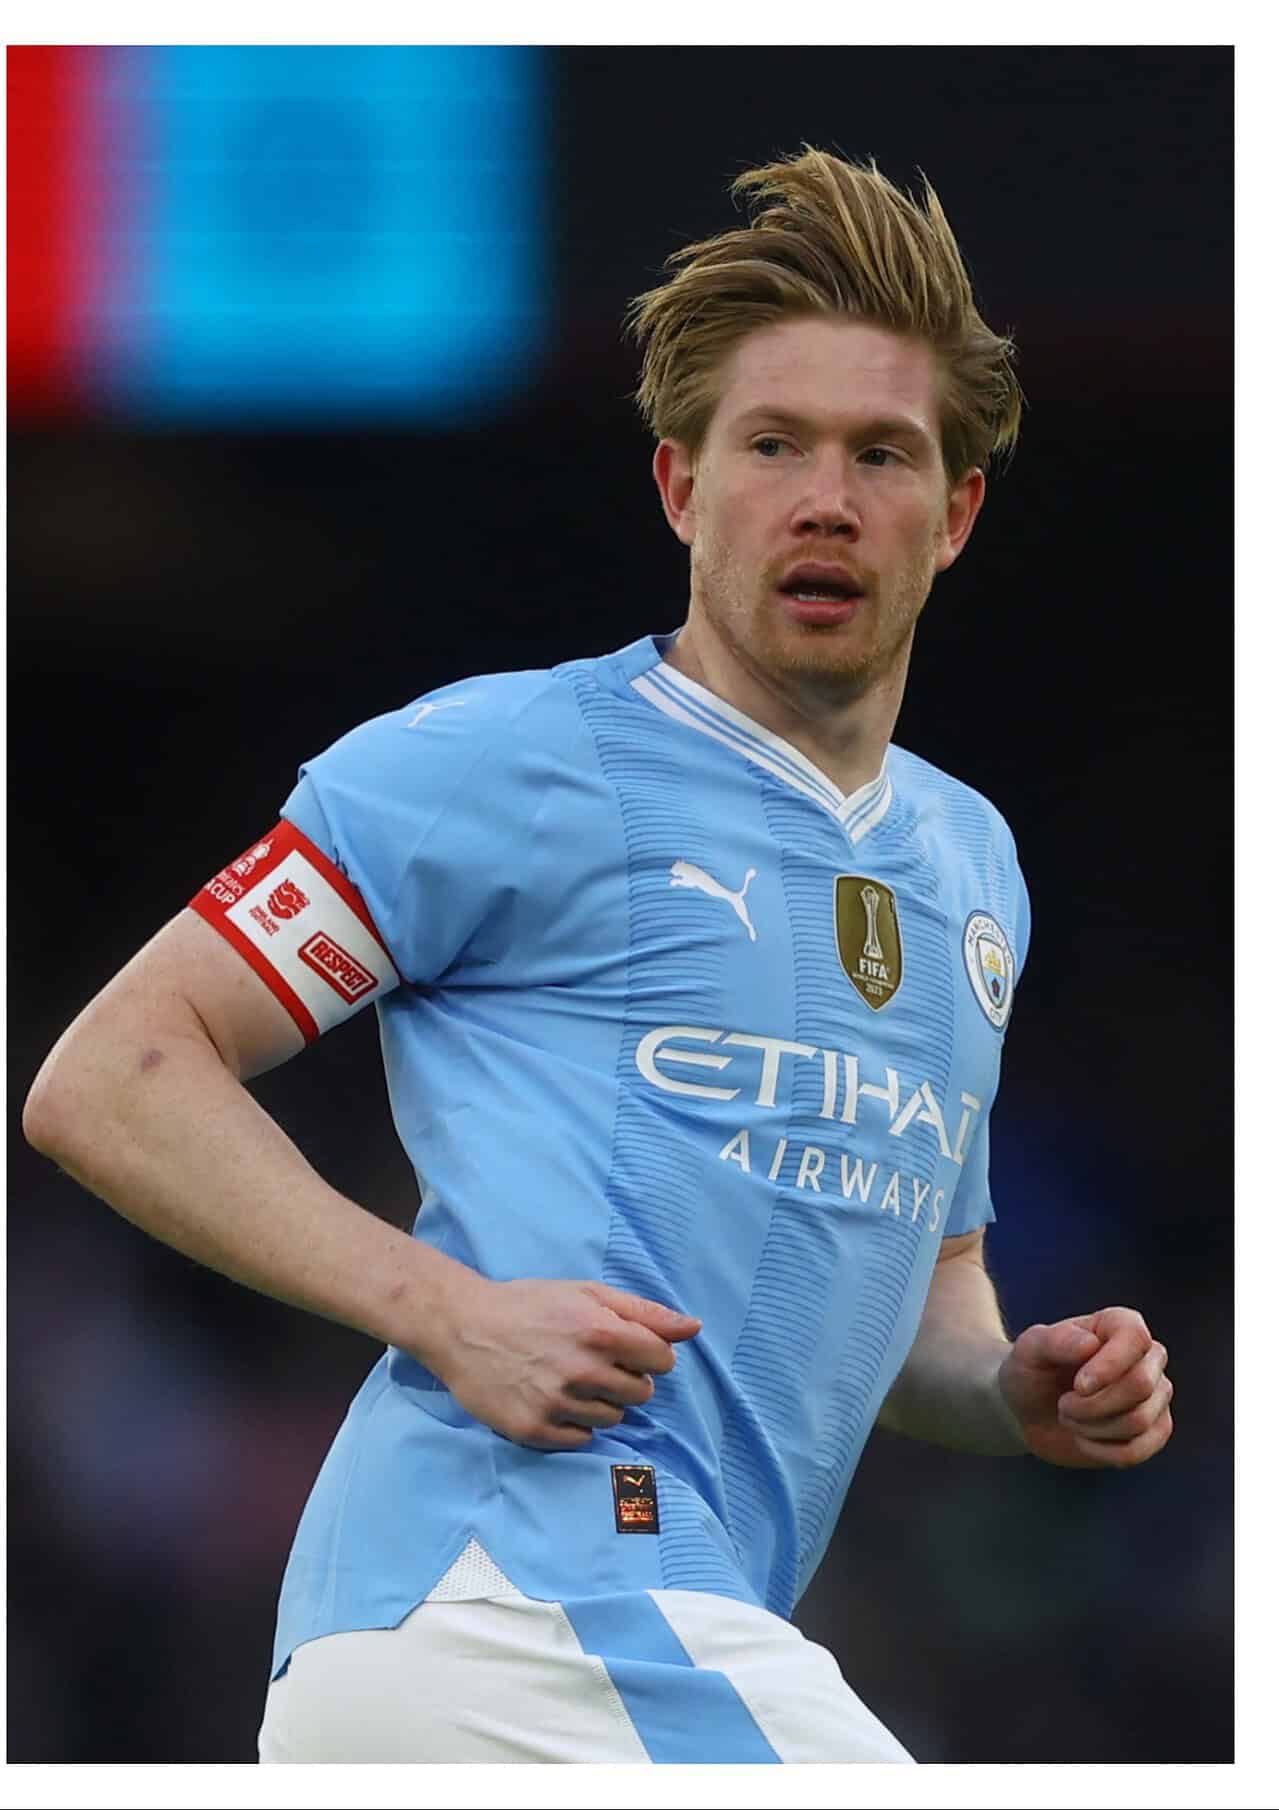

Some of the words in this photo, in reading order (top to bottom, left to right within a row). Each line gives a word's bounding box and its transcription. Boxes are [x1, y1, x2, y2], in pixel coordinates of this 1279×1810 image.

[309, 939, 370, 991] RESPECT
[859, 958, 889, 980] FIFA
[719, 1129, 946, 1234] AIRWAYS
